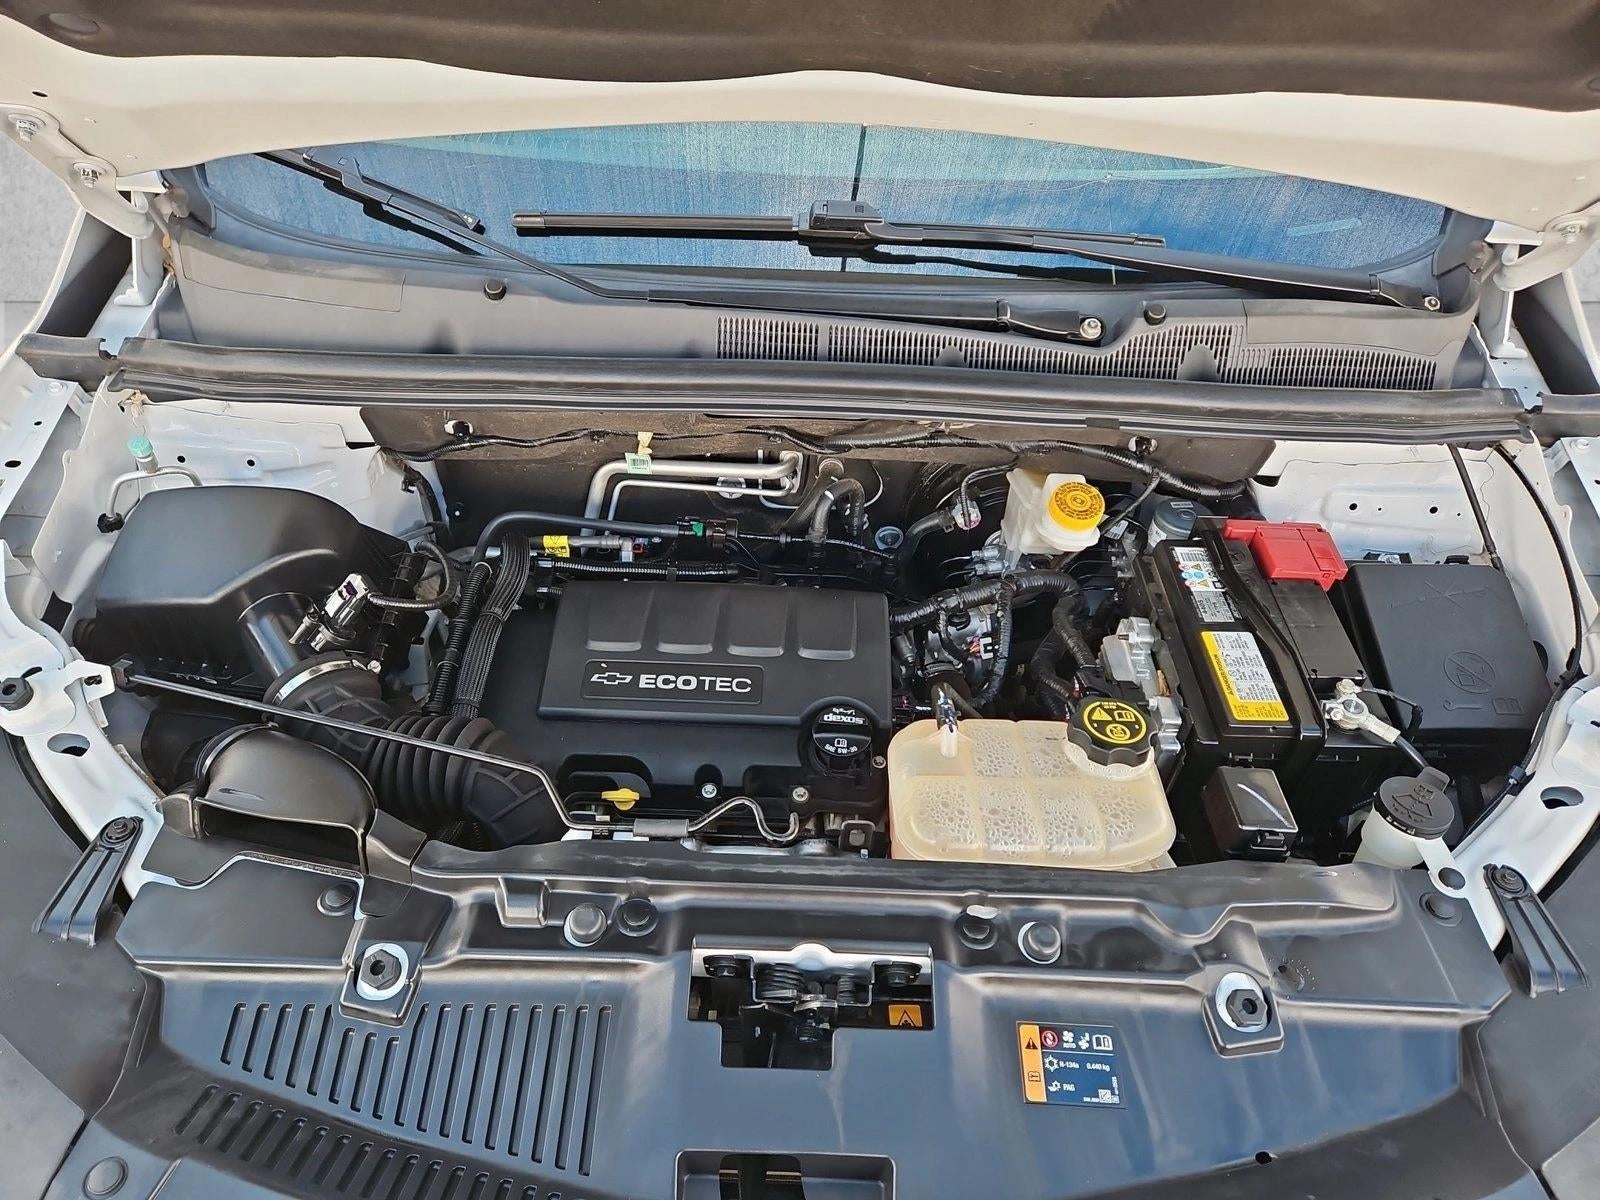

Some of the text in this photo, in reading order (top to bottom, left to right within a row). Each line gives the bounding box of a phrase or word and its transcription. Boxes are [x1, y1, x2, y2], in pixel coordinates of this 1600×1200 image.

[638, 674, 752, 693] ECOTEC
[823, 713, 865, 724] dexos
[824, 743, 858, 754] SAE 5W-30
[1063, 1083, 1075, 1091] PAG
